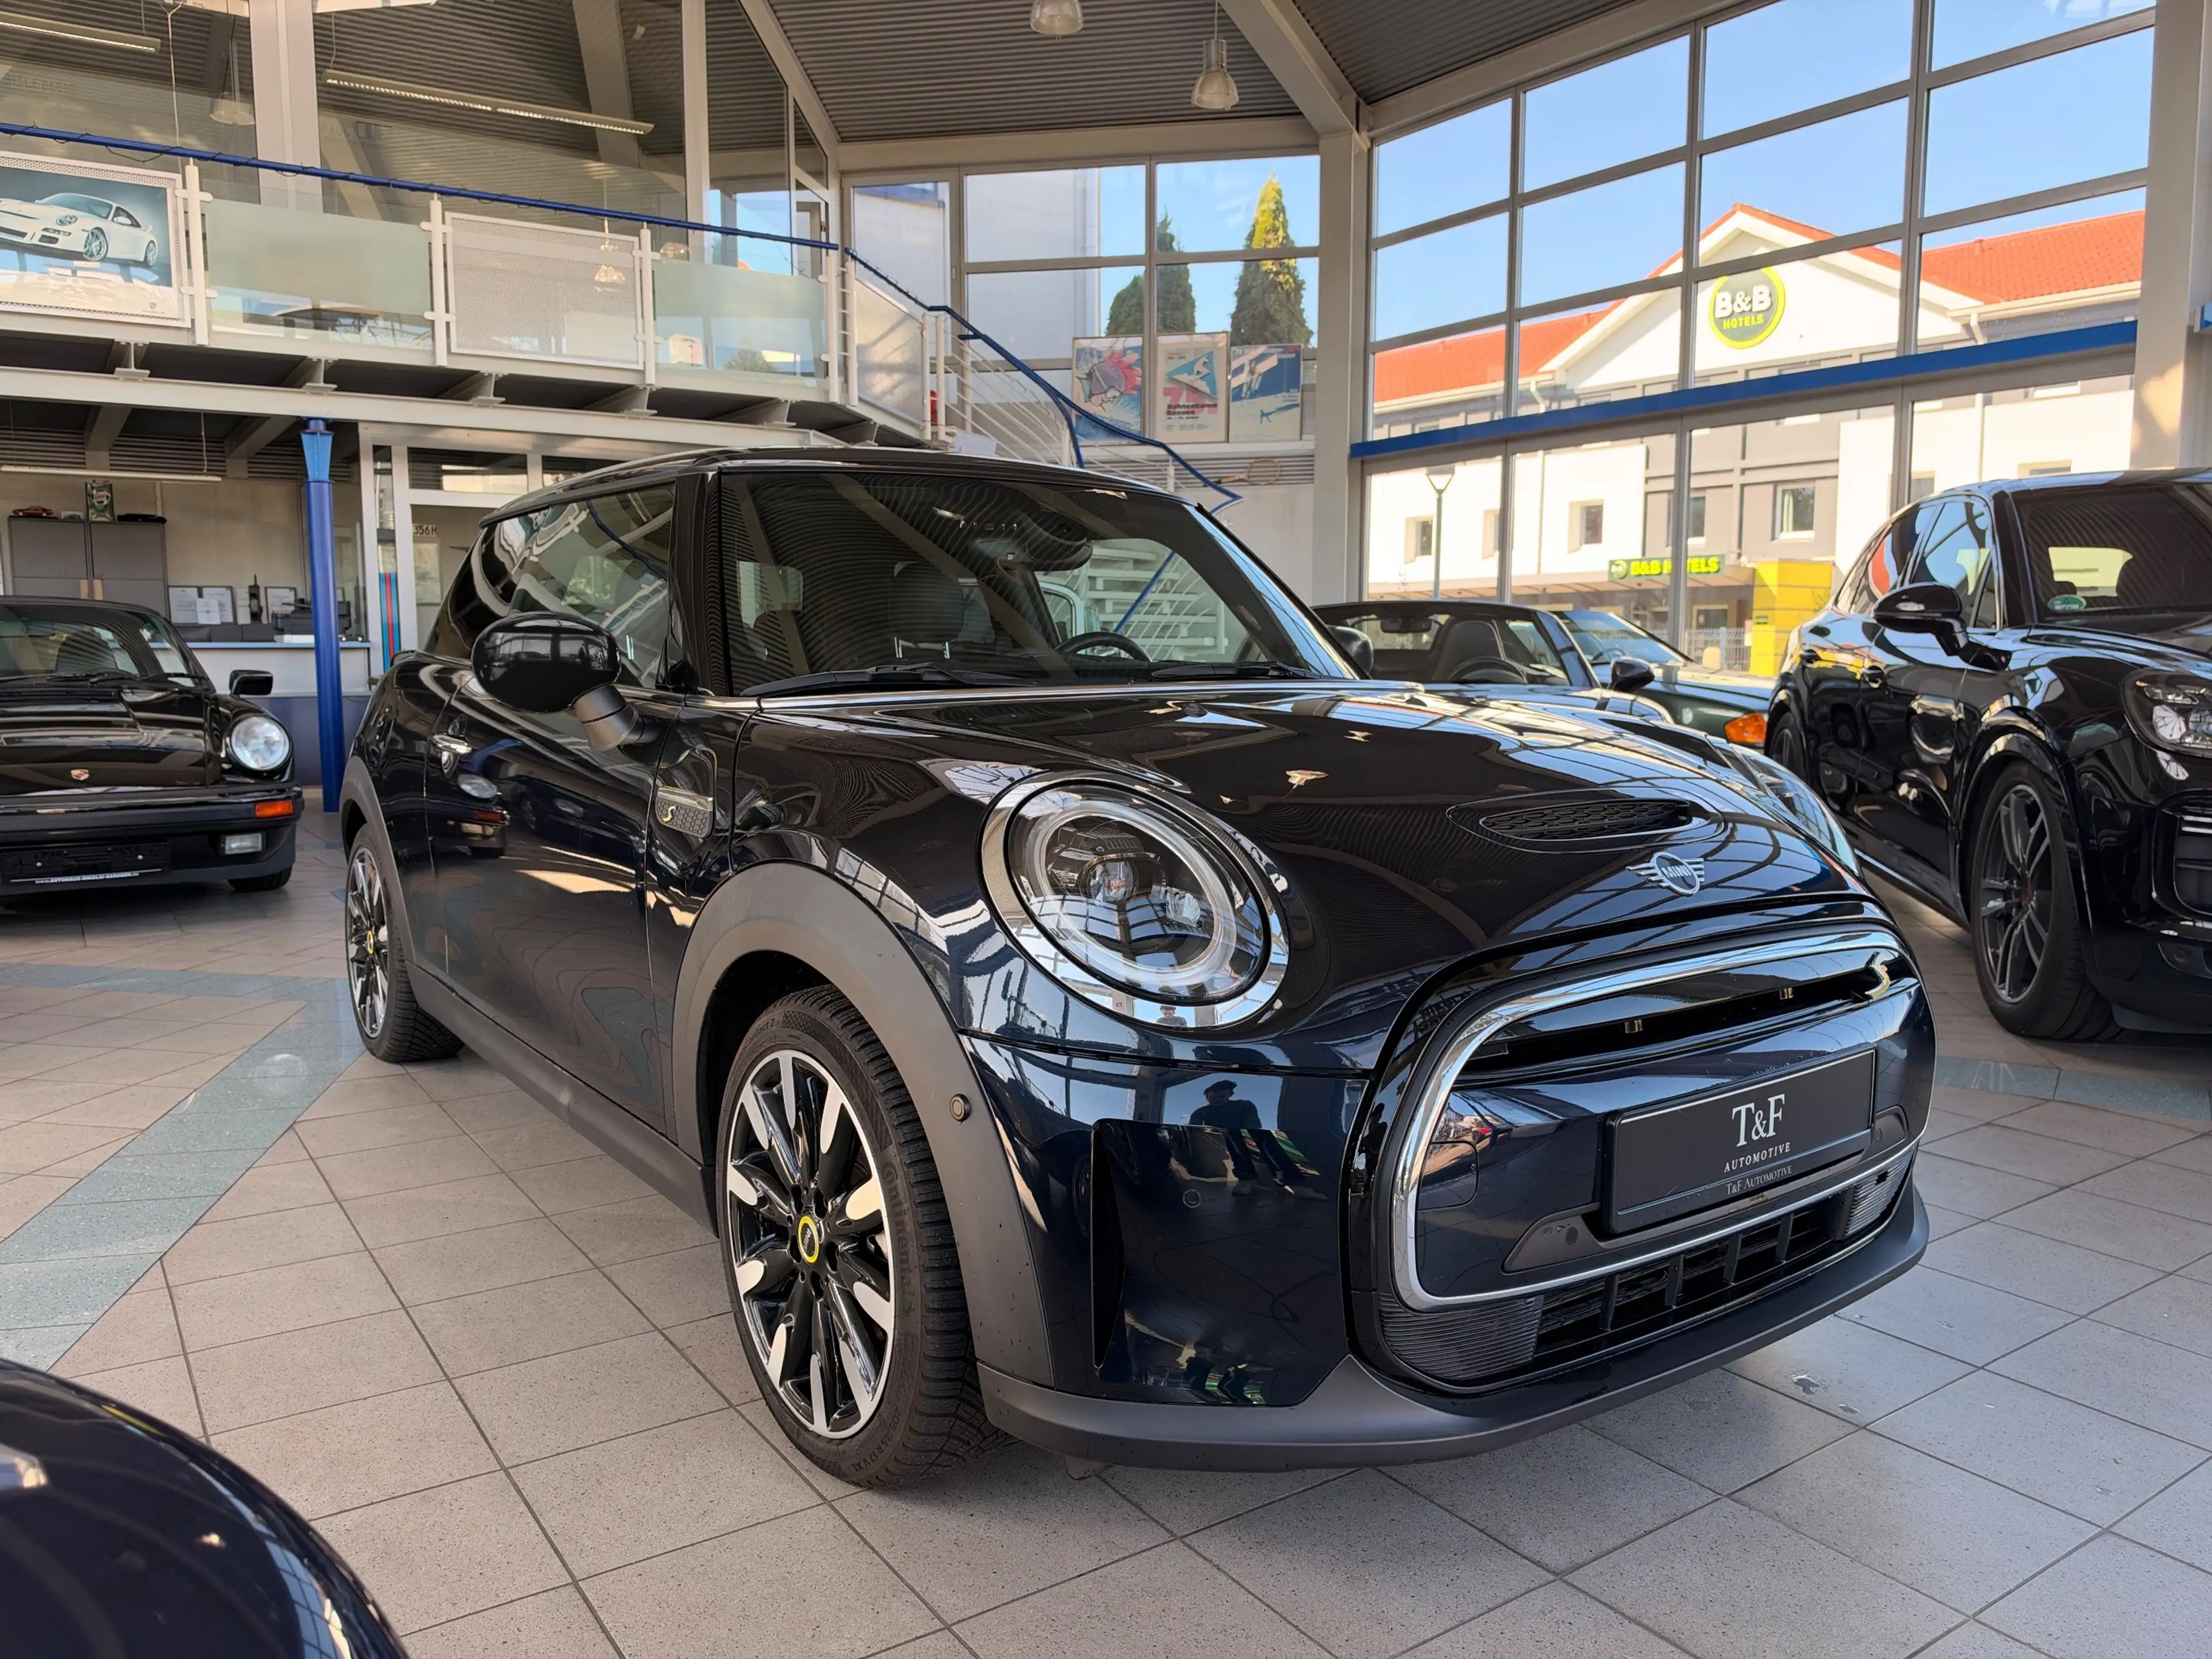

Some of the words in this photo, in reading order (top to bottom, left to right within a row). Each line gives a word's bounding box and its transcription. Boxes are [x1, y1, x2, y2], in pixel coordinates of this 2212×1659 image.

[1715, 284, 1772, 319] B&B
[1723, 316, 1764, 329] HOTELS
[1631, 560, 1661, 575] B&B
[662, 805, 677, 822] S
[1660, 865, 1692, 878] MINI
[770, 1018, 775, 1028] 2
[1732, 1093, 1785, 1147] T&F
[1724, 1142, 1790, 1173] AUTOMOTIVE
[1726, 1179, 1742, 1195] T&F
[1744, 1165, 1793, 1190] AUTOMOTIVE
